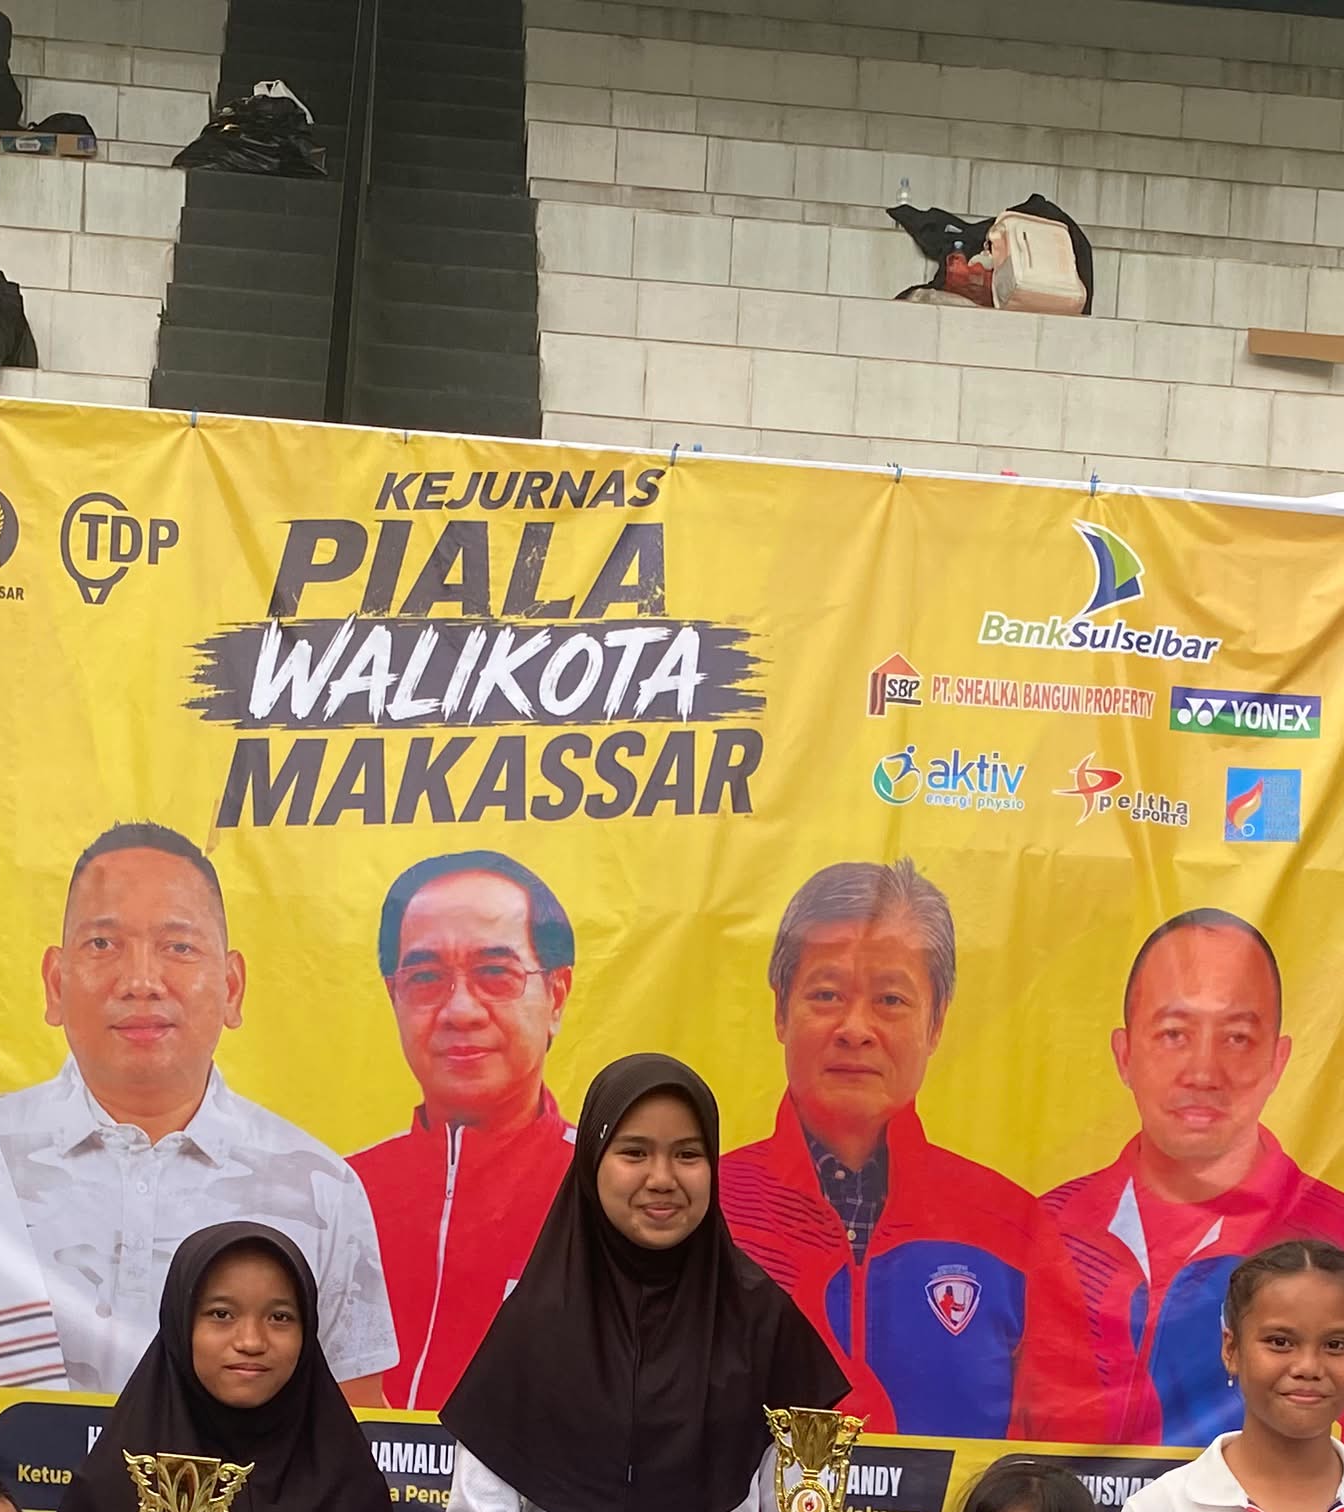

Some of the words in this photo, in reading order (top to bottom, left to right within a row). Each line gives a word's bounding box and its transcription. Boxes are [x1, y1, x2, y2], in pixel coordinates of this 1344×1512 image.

[375, 469, 666, 511] KEJURNAS
[266, 519, 666, 619] PIALA
[248, 614, 708, 725] WALIKOTA
[887, 679, 920, 699] SBP
[933, 676, 951, 702] PT.
[956, 678, 1018, 708] SHEALKA
[1023, 684, 1081, 713] BANGUN
[1085, 688, 1154, 718] PROPERTY
[1232, 700, 1312, 732] YONEX
[215, 728, 764, 828] MAKASSAR
[927, 750, 1025, 794] aktiv
[925, 793, 972, 808] energi
[977, 796, 1024, 810] physio
[1099, 792, 1188, 815] peltha
[1132, 808, 1188, 826] SPORTS
[17, 1464, 73, 1484] Ketua
[371, 1441, 454, 1475] AMALU
[405, 1484, 451, 1508] Peng
